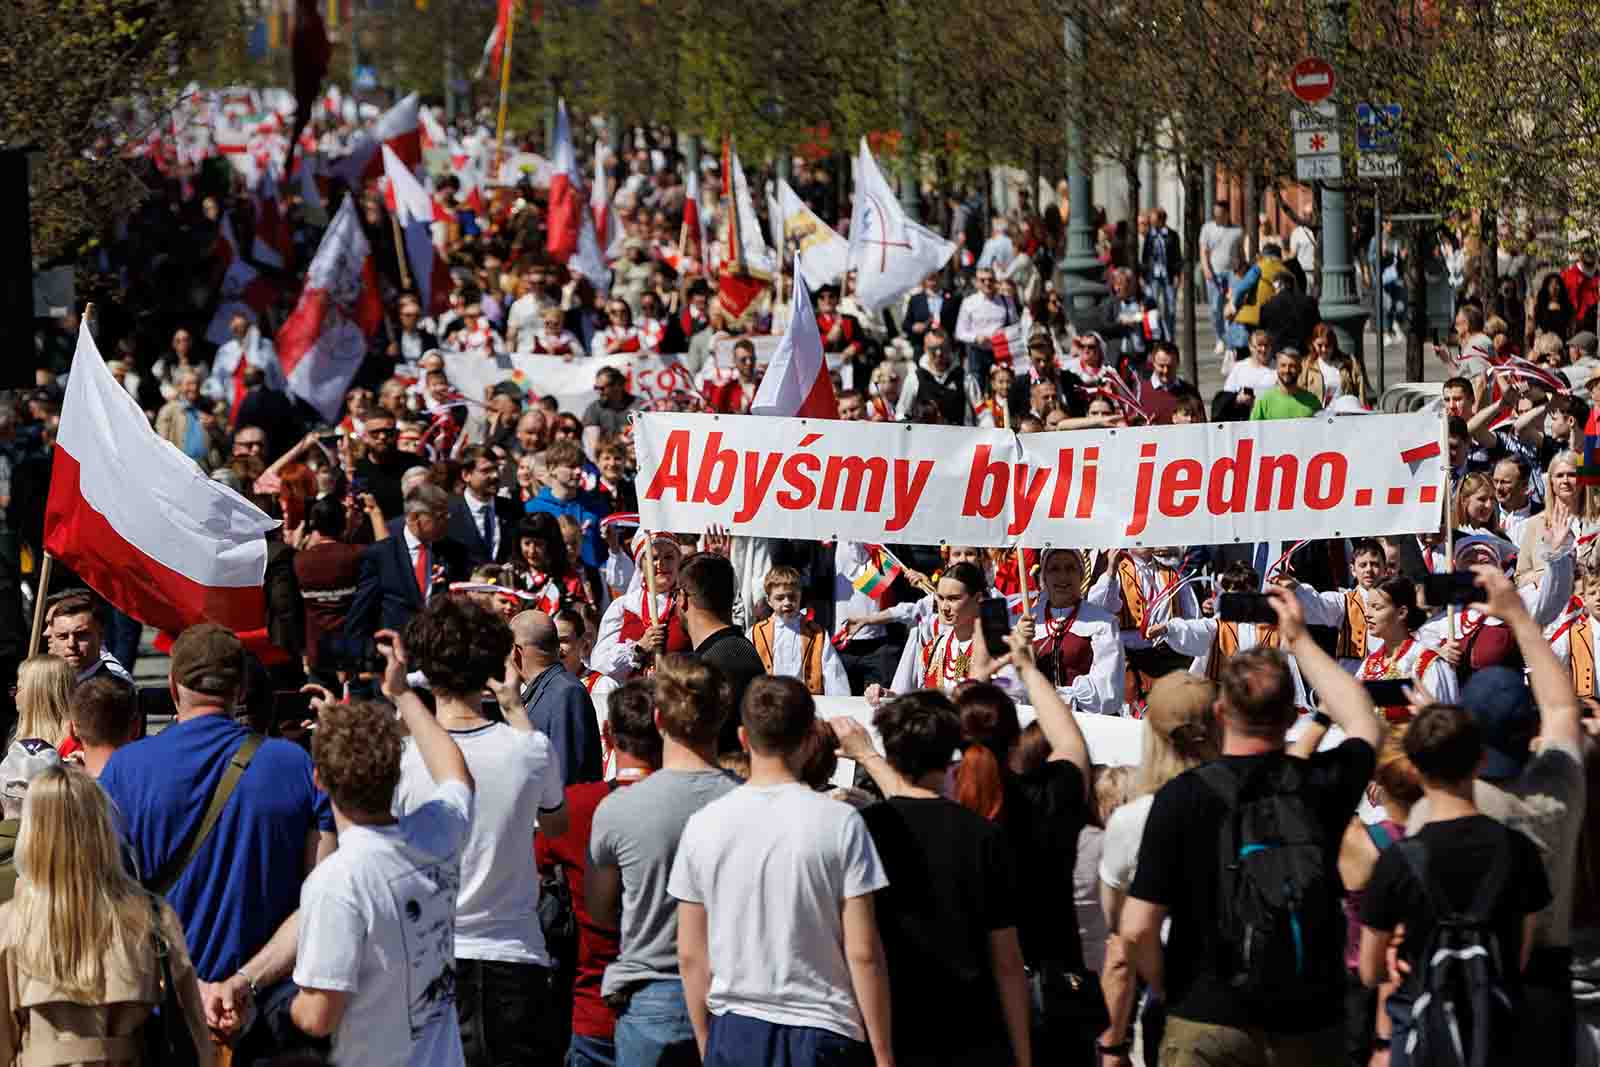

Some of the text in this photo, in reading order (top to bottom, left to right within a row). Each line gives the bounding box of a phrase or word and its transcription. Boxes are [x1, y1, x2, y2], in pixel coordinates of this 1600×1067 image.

[645, 429, 1437, 537] Abyśmy byli jedno...
